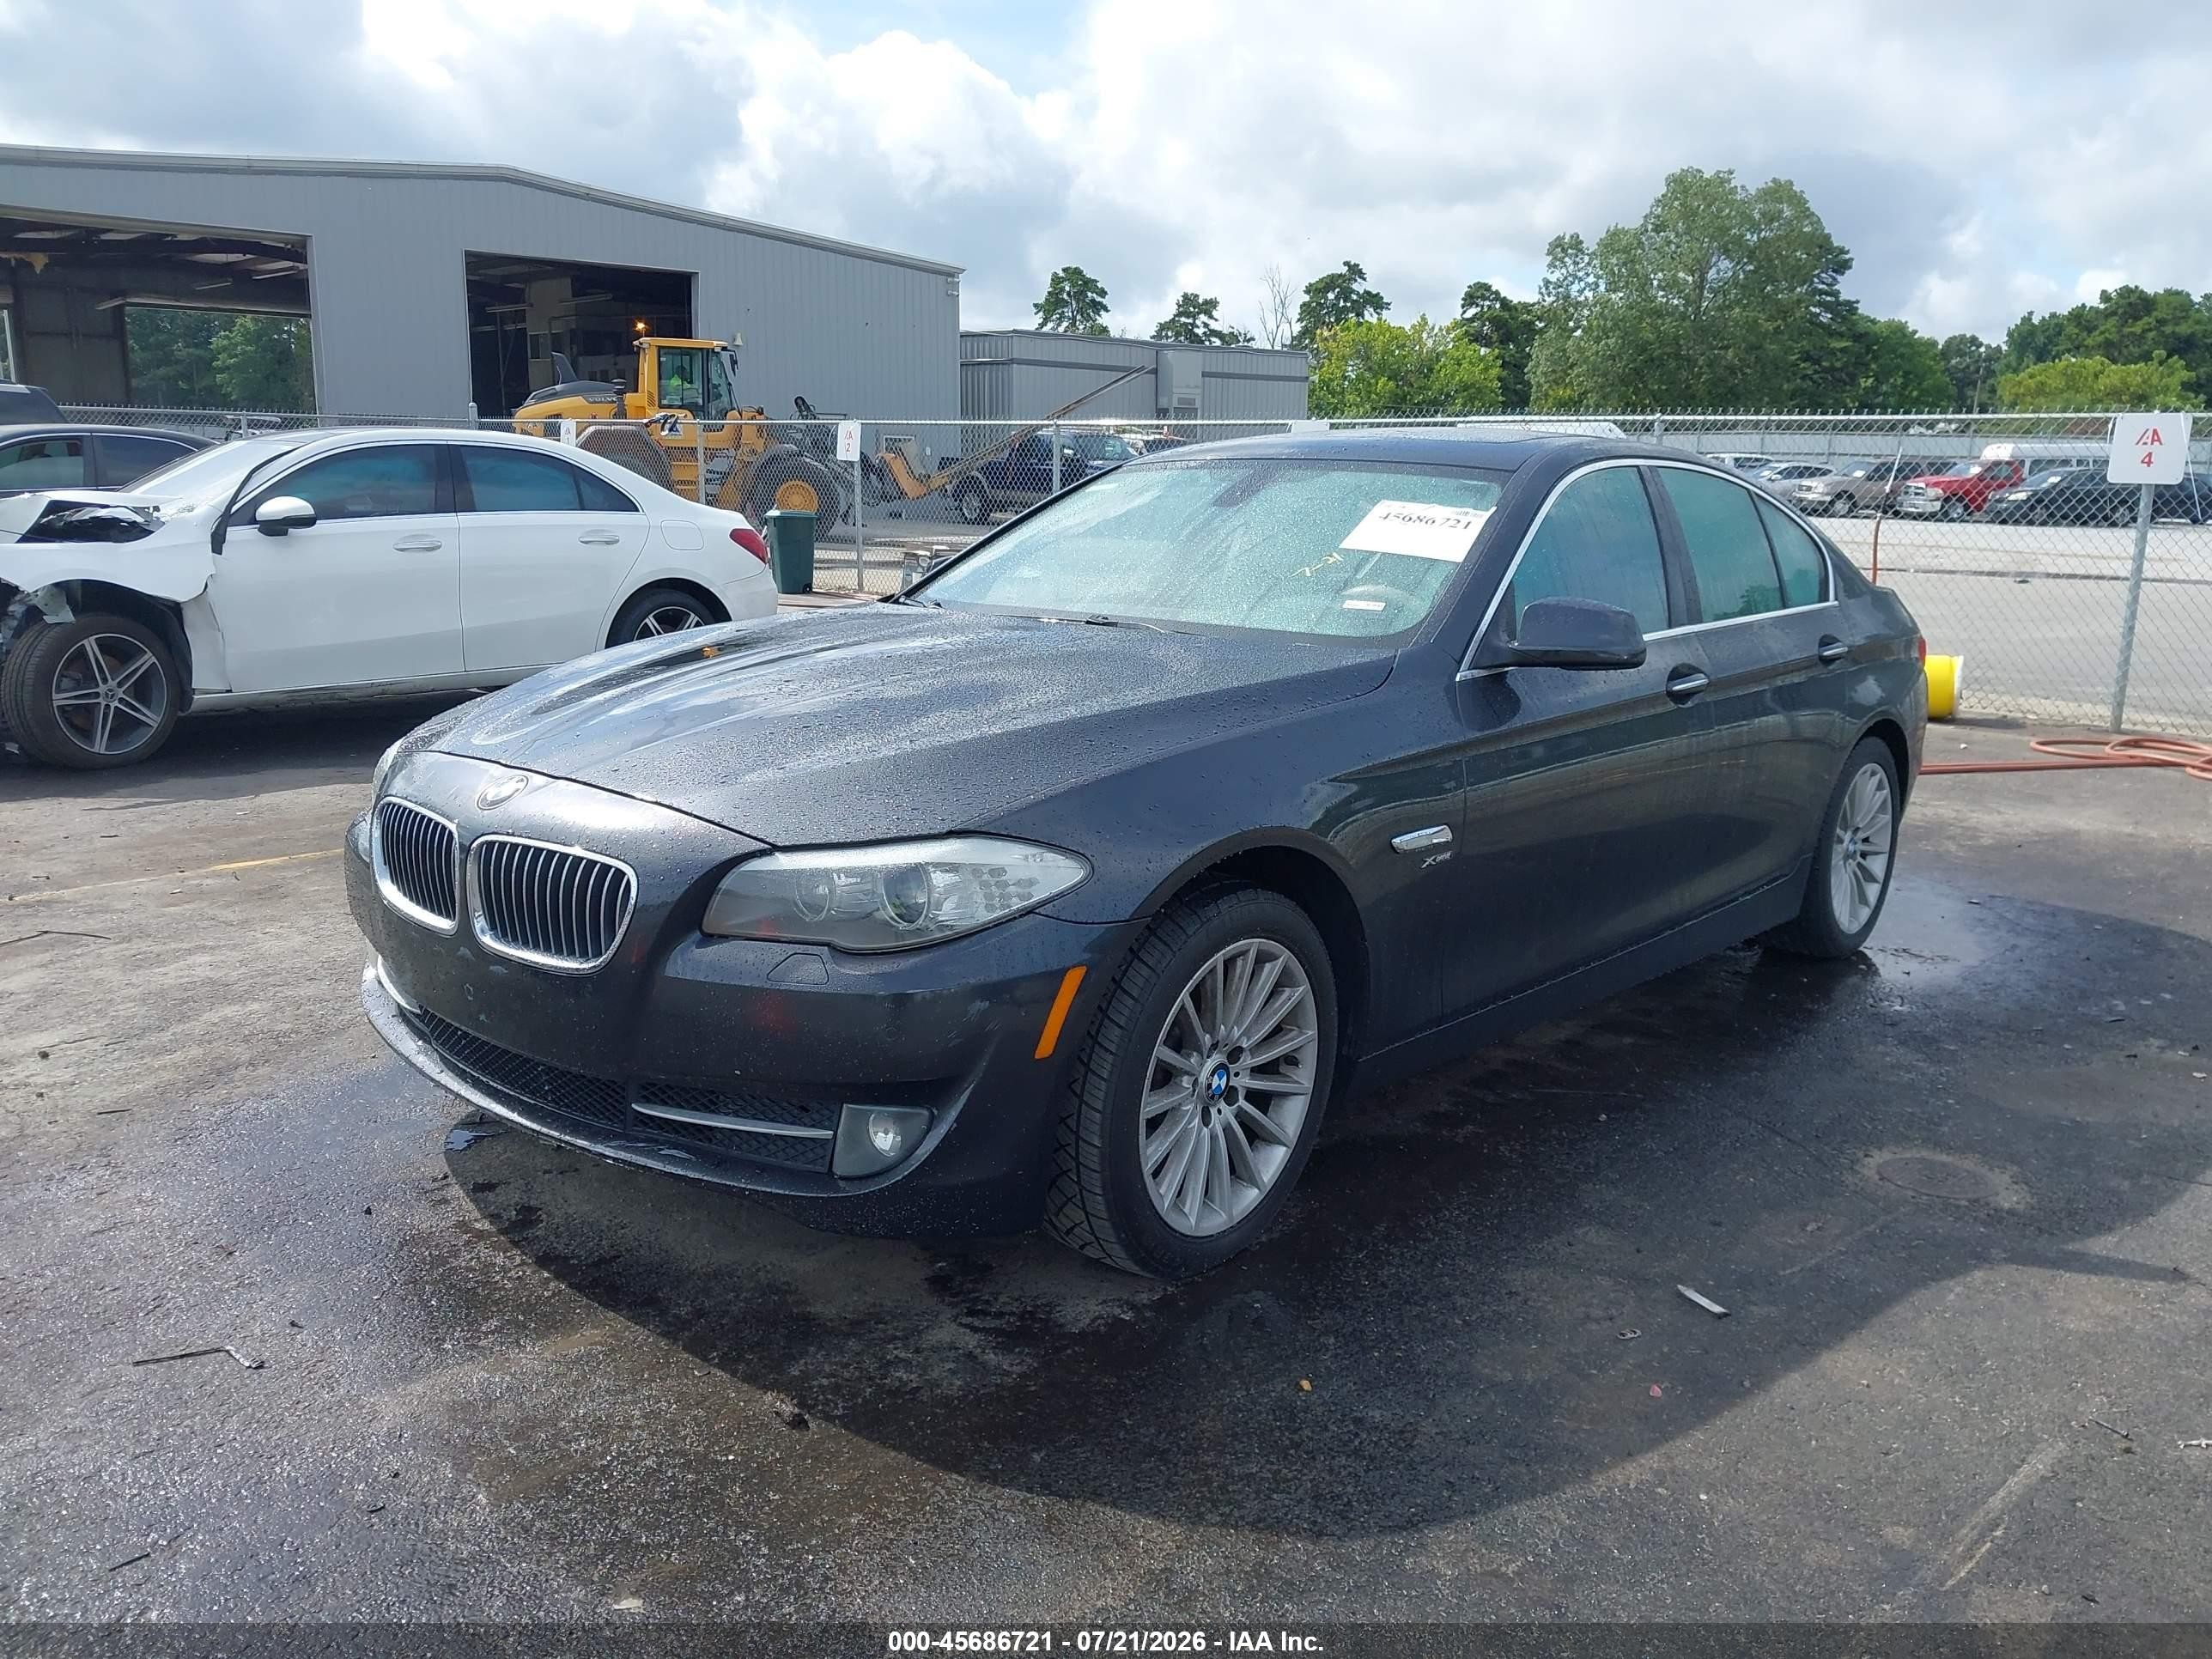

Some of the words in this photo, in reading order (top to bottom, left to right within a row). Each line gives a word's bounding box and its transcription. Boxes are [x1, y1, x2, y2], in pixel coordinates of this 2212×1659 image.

[846, 443, 851, 452] 2
[2141, 452, 2154, 467] 4
[1378, 512, 1472, 530] 45686721
